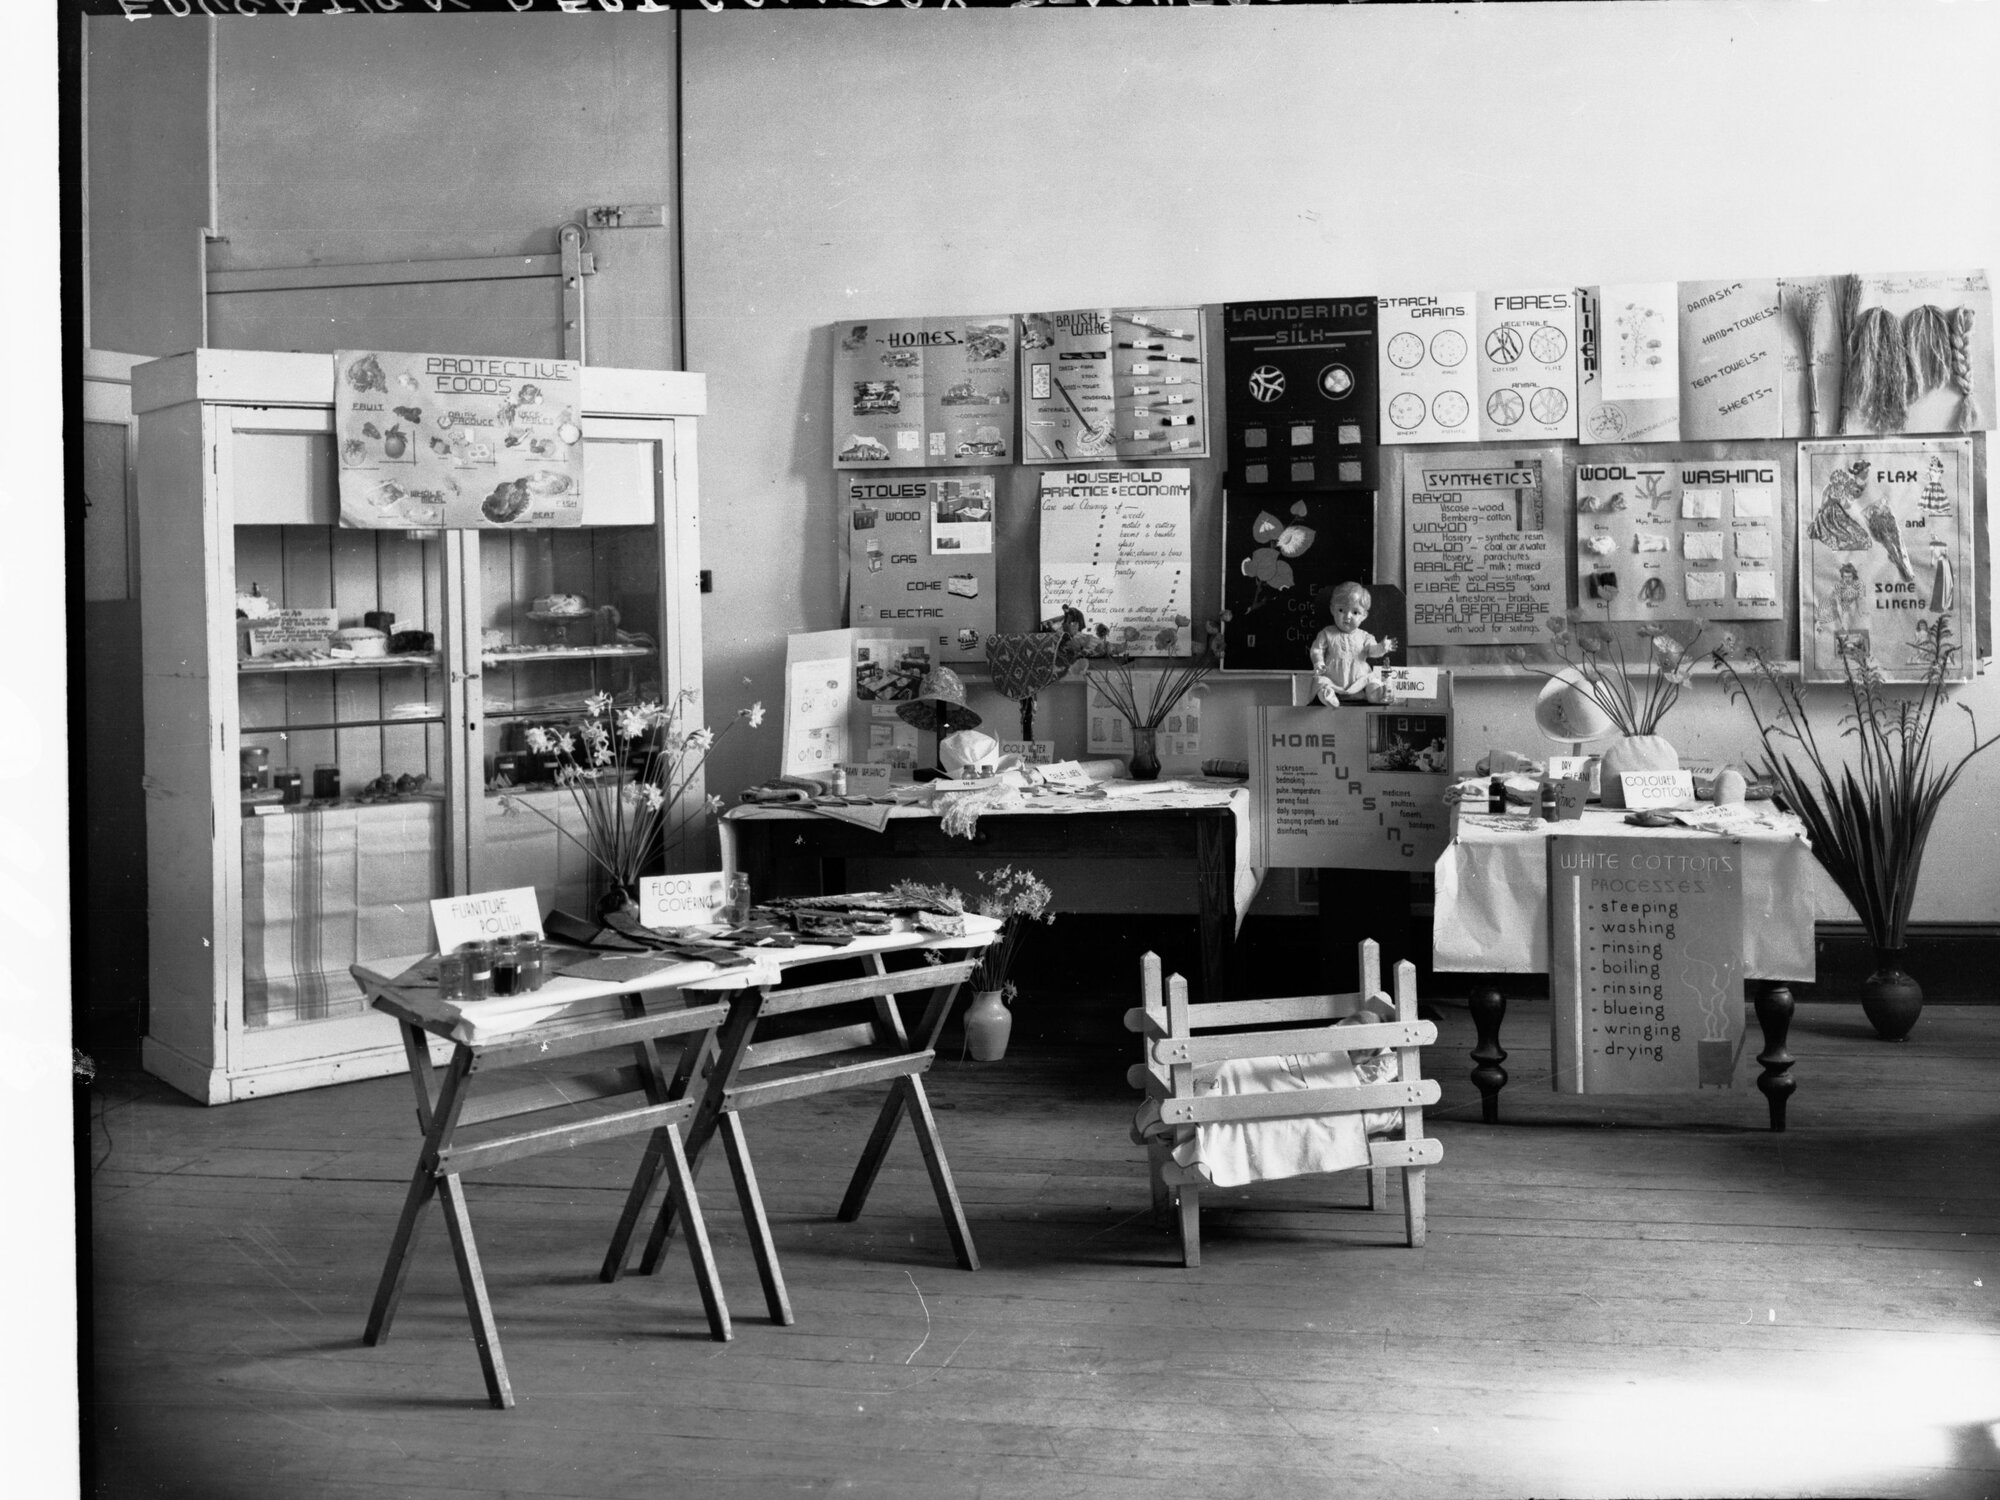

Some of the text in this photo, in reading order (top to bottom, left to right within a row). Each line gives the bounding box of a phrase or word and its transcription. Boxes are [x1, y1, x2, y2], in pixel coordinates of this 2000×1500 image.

[1380, 296, 1437, 308] STARCH
[1232, 304, 1367, 321] LAUNDERING
[1276, 329, 1323, 343] SILK
[427, 358, 568, 378] PROTECTIVE
[437, 376, 511, 394] FOODS
[1067, 472, 1162, 484] HOUSEHOLD
[1429, 473, 1532, 486] SYNTHETICS
[1581, 467, 1636, 481] WOOL
[1683, 469, 1773, 484] WASHING
[1877, 471, 1918, 483] FLAX
[1042, 486, 1108, 497] PRACTICE
[1119, 485, 1189, 496] ECONOMY
[1413, 493, 1462, 503] RAYON
[1042, 499, 1056, 510] Care
[1441, 502, 1504, 512] Viscose wood
[886, 512, 920, 521] WOOD
[1442, 513, 1511, 524] Bemberg cotton
[1905, 517, 1926, 528] and
[1413, 523, 1466, 532] VINYON
[1443, 534, 1472, 544] Hosiery
[1485, 534, 1520, 544] synthetic
[1414, 543, 1463, 551] NYLON
[891, 555, 917, 563] GAS
[1484, 554, 1530, 564] parachutes
[1414, 562, 1540, 571] ARALAC mixed
[1444, 573, 1461, 581] with
[1468, 573, 1488, 581] wool
[1414, 583, 1459, 592] FIBRE
[1466, 582, 1515, 592] GLASS
[1875, 582, 1916, 593] SOME
[1456, 594, 1496, 602] limestone
[1876, 598, 1926, 609] LINENS
[880, 608, 943, 618] ELECTRIC
[1415, 603, 1549, 613] SOYA BEAN FIBRE
[1415, 613, 1534, 623] PEANUT FIBRES
[1468, 624, 1485, 632] wool
[1492, 624, 1502, 632] for
[1272, 734, 1335, 747] HOME
[1562, 761, 1572, 770] DRY
[1625, 776, 1676, 786] COLOURED
[1642, 787, 1691, 798] COTTONS
[1560, 853, 1733, 873] WHITE COTTONS
[652, 880, 692, 896] FLOOR
[1591, 879, 1706, 893] PROCESSES
[451, 897, 506, 919] FURNITURE
[658, 895, 714, 912] COVERINGS
[1601, 901, 1678, 918] steeping
[1602, 919, 1675, 939] washing
[1602, 941, 1662, 961] rinsing
[1602, 959, 1660, 980] boiling
[1603, 984, 1662, 1000] rinsing
[1604, 1000, 1664, 1021] blueing
[1605, 1023, 1680, 1041] wringing
[1605, 1042, 1663, 1061] drying
